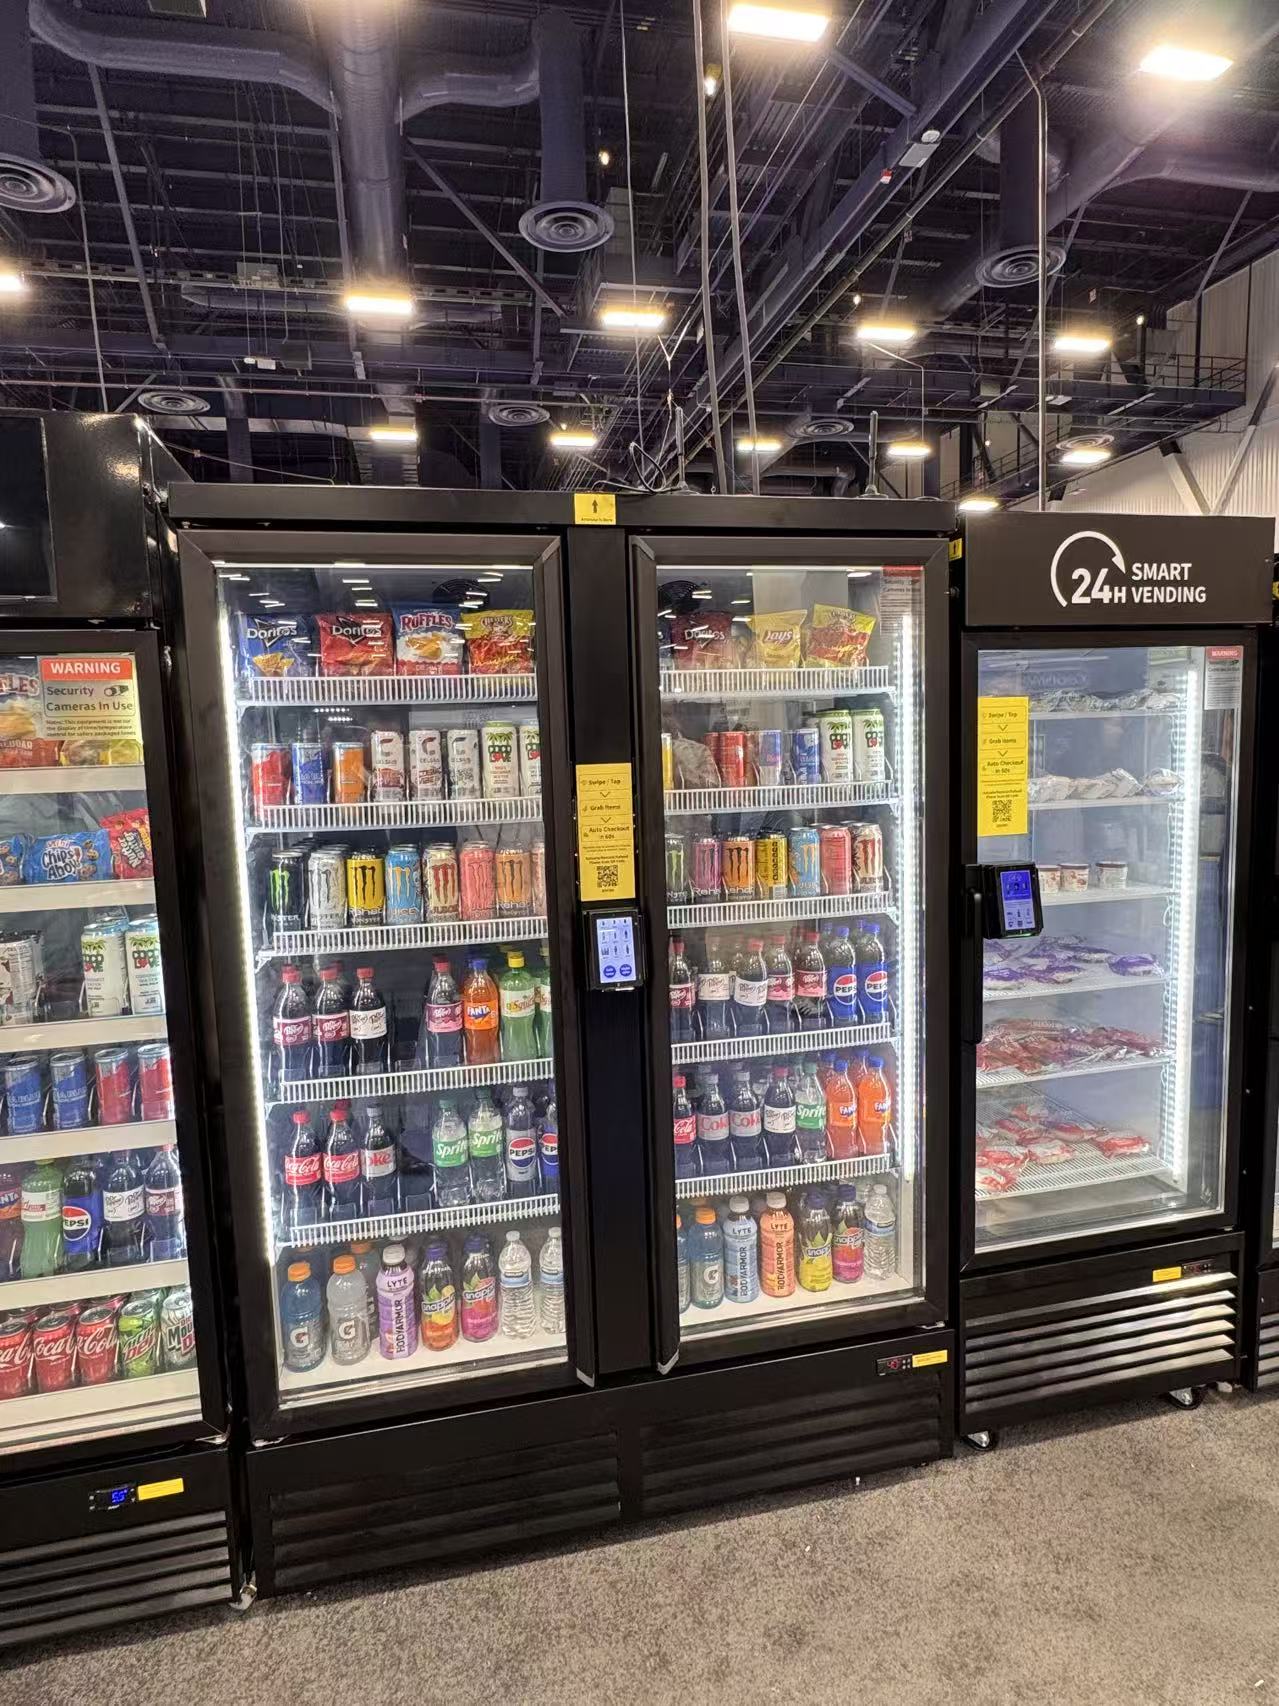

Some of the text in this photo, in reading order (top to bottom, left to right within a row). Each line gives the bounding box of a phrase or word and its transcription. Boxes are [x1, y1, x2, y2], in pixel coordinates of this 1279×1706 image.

[1131, 562, 1192, 580] SMART
[1071, 567, 1126, 604] 24H
[1131, 586, 1207, 603] VENDING
[400, 613, 453, 632] RUFFLES
[247, 625, 298, 640] Doritos
[51, 662, 121, 674] WARNING
[46, 686, 95, 697] Security
[46, 701, 133, 711] Cameras In Use
[42, 848, 75, 868] Chips
[467, 1005, 490, 1016] FANTA
[702, 1117, 729, 1131] Cok
[472, 1130, 502, 1148] Sprit
[63, 1219, 89, 1230] EPSI
[733, 1227, 752, 1235] LYTE
[387, 1277, 408, 1288] LYTE
